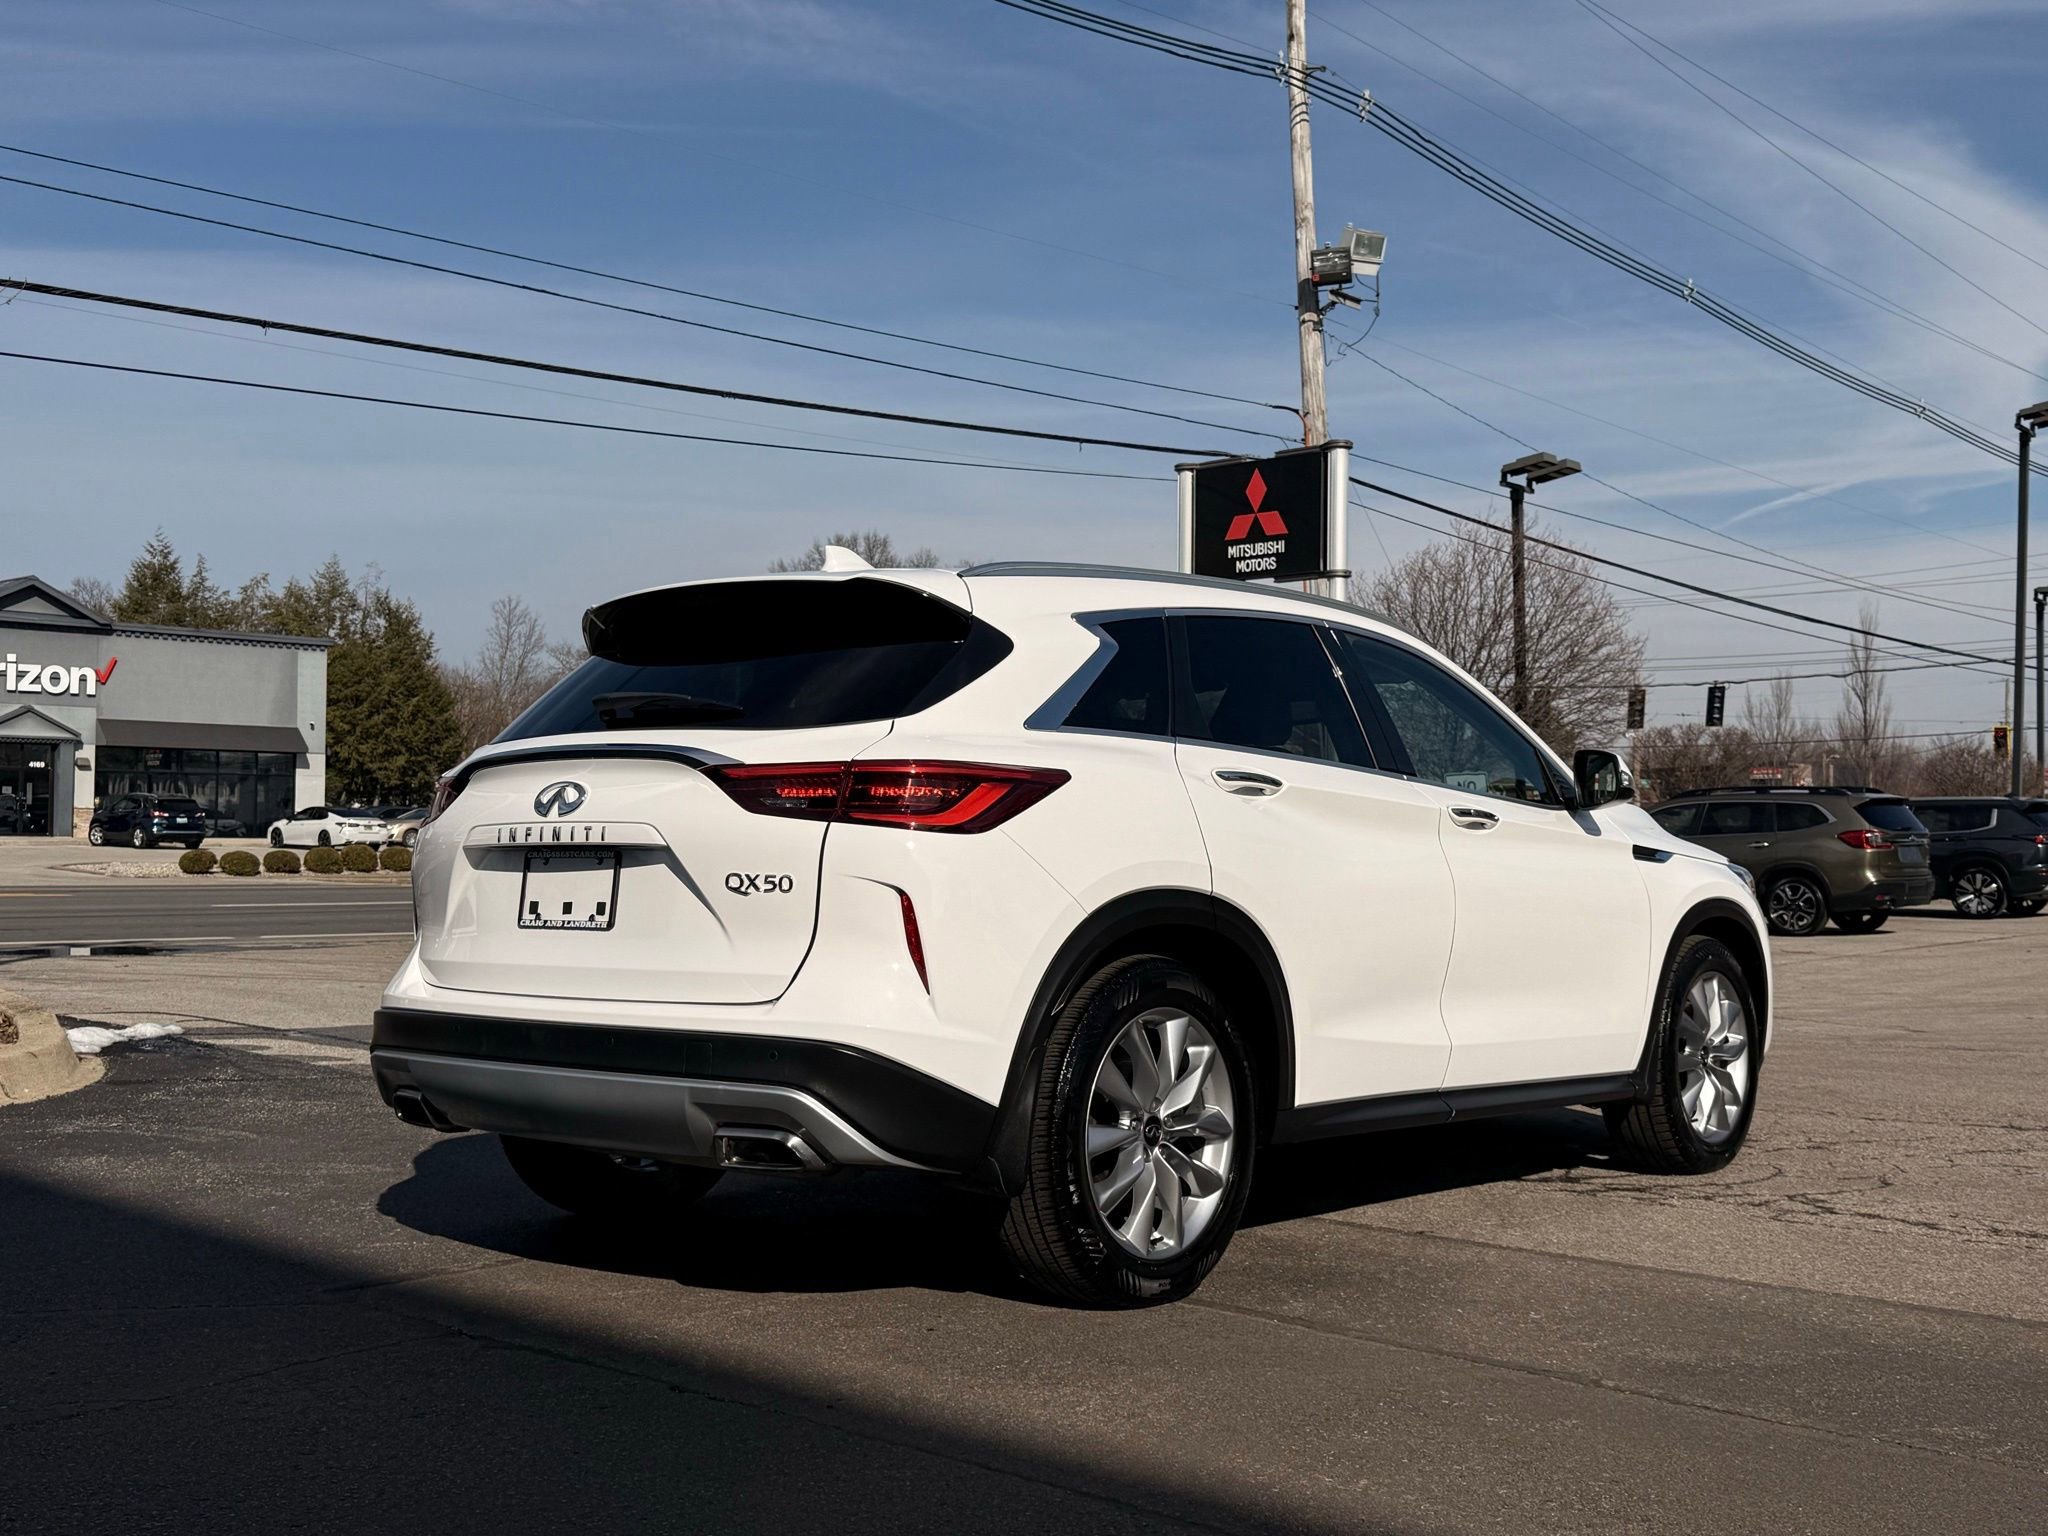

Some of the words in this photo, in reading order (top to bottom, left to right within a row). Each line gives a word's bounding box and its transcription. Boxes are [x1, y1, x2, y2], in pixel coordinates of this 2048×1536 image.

[1228, 540, 1285, 559] MITSUBISHI
[1236, 557, 1277, 573] MOTORS
[497, 826, 606, 843] INFINITI
[725, 872, 794, 897] QX50
[520, 919, 544, 927] CRAIG
[545, 920, 562, 928] AND
[563, 920, 608, 929] LANDRETH
